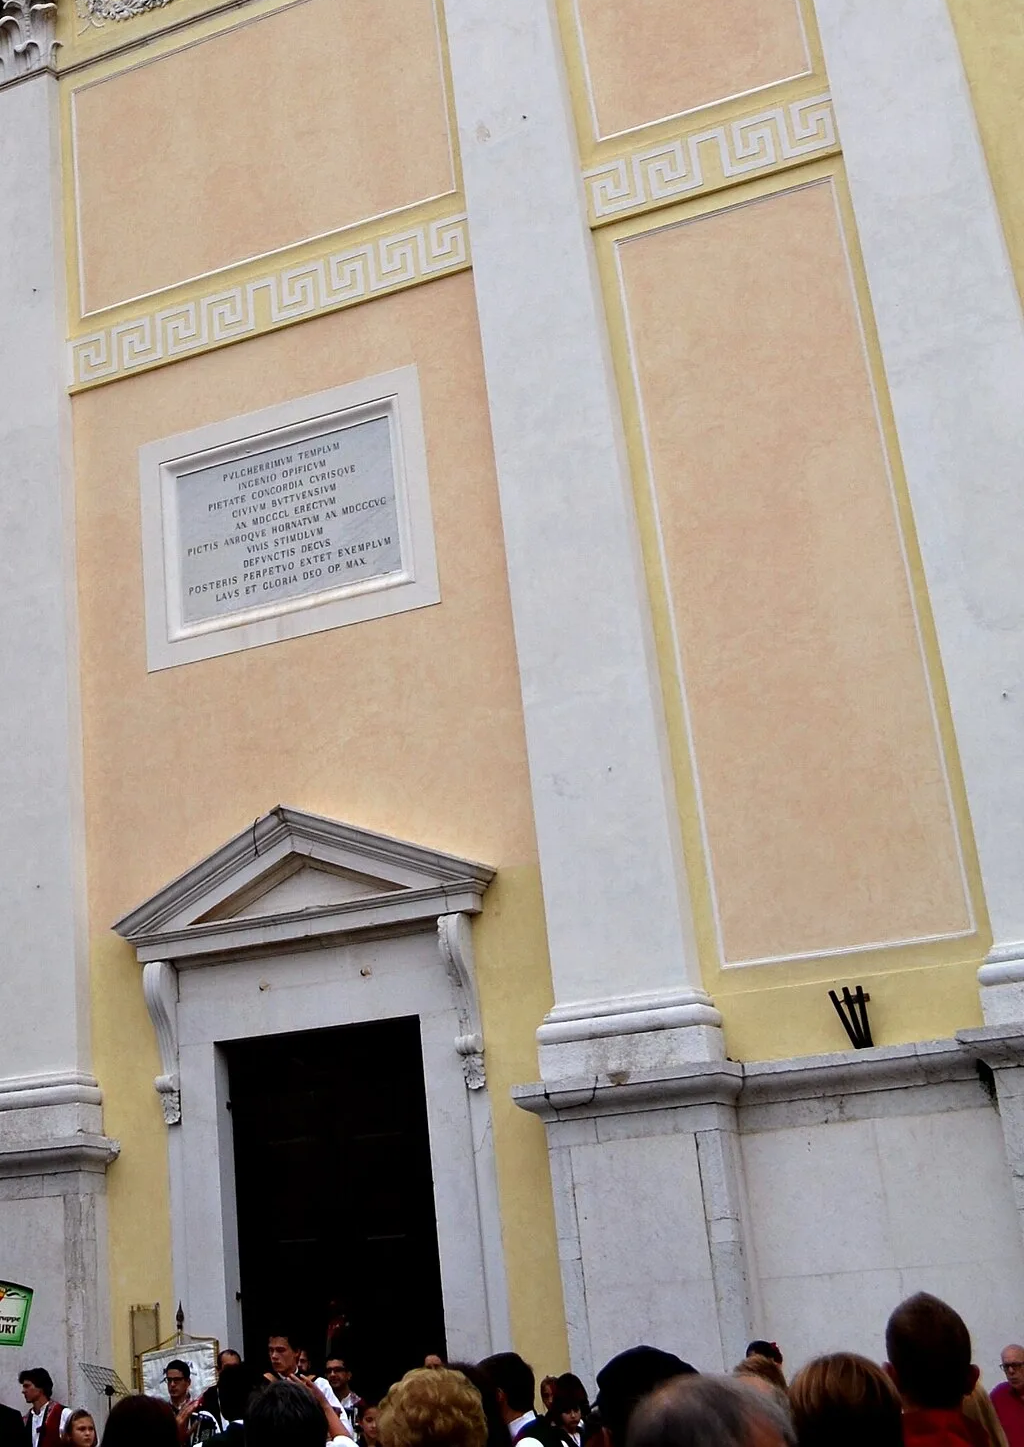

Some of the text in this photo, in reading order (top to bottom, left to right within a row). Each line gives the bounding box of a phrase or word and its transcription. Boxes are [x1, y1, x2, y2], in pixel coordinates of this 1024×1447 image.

[208, 465, 355, 511] PIETATE CONCORDIA CVRISQVE
[231, 502, 265, 518] CIVIVM
[294, 496, 336, 514] ERECTVM
[187, 540, 218, 556] PICTIS
[243, 538, 330, 568] DEFVNCTIS DECVS
[246, 541, 268, 553] VIVIS
[188, 575, 237, 594] POSTERIS
[243, 561, 294, 581] PERPETVO
[299, 551, 331, 567] EXTET
[245, 584, 256, 594] ET
[302, 568, 321, 580] DEO
